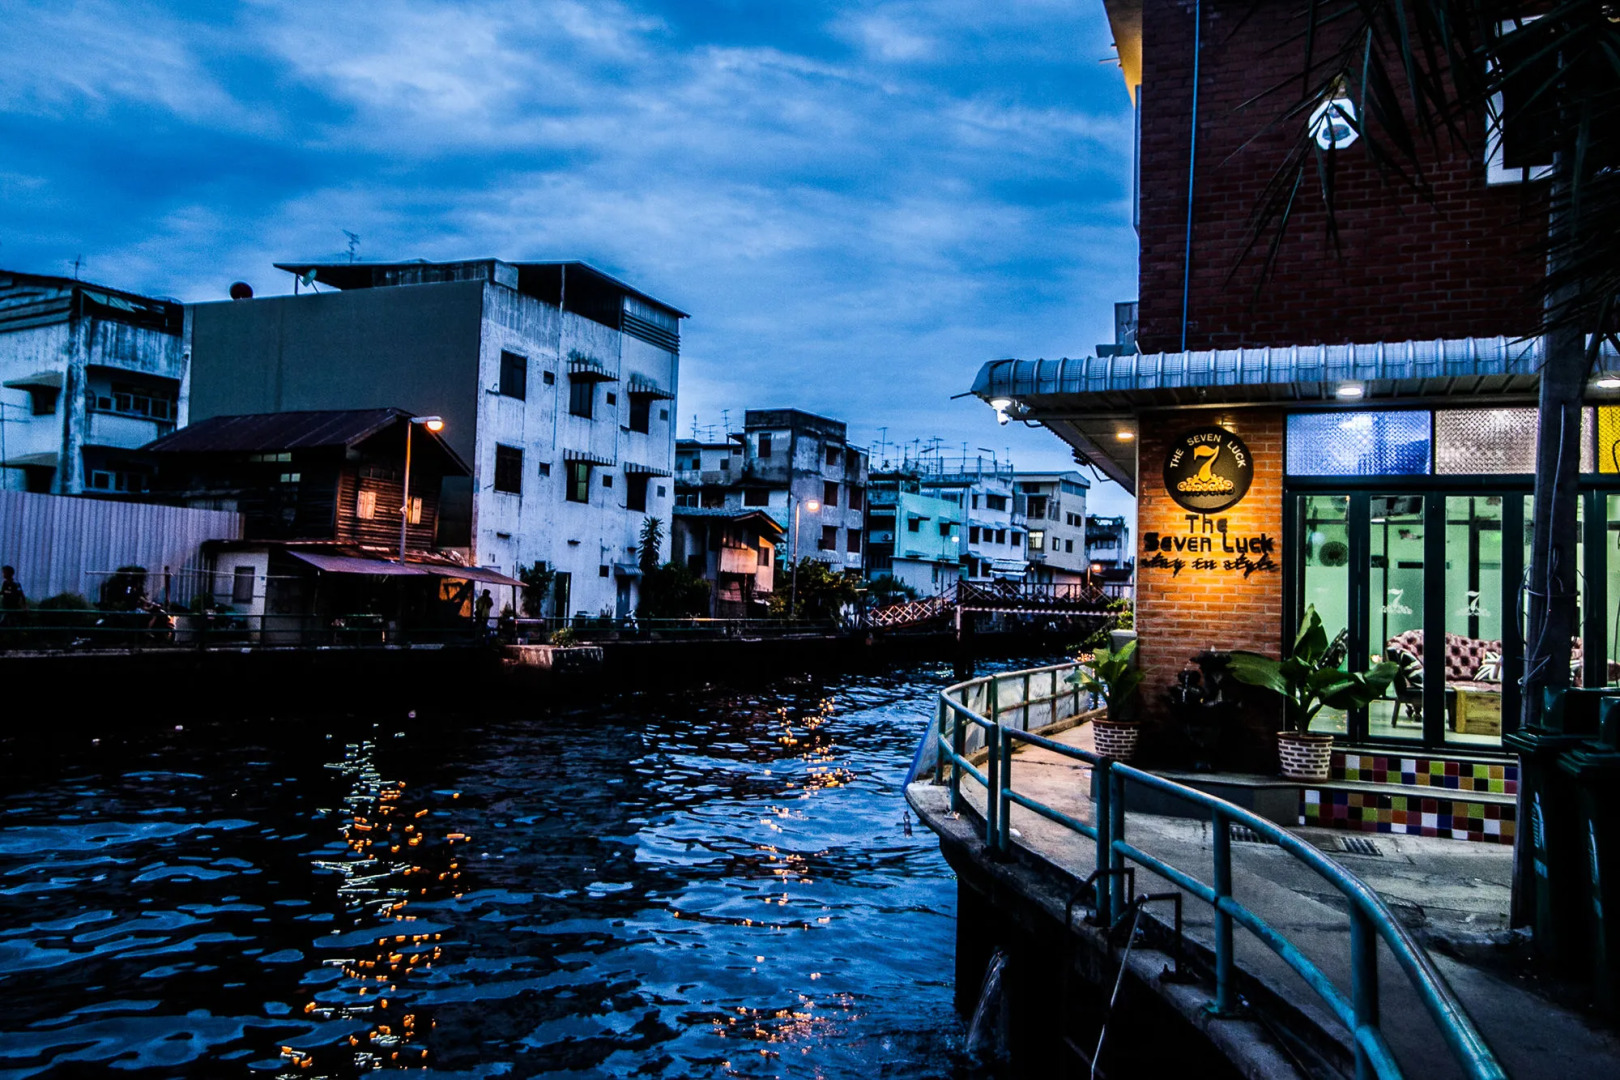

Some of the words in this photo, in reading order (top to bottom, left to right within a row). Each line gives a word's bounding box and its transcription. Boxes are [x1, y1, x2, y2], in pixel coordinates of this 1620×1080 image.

[1170, 448, 1184, 468] THE
[1187, 433, 1222, 446] SEVEN
[1227, 440, 1246, 468] LUCK
[1194, 445, 1219, 482] 7
[1185, 513, 1228, 533] The
[1144, 532, 1212, 552] Seven
[1223, 532, 1275, 553] Luck
